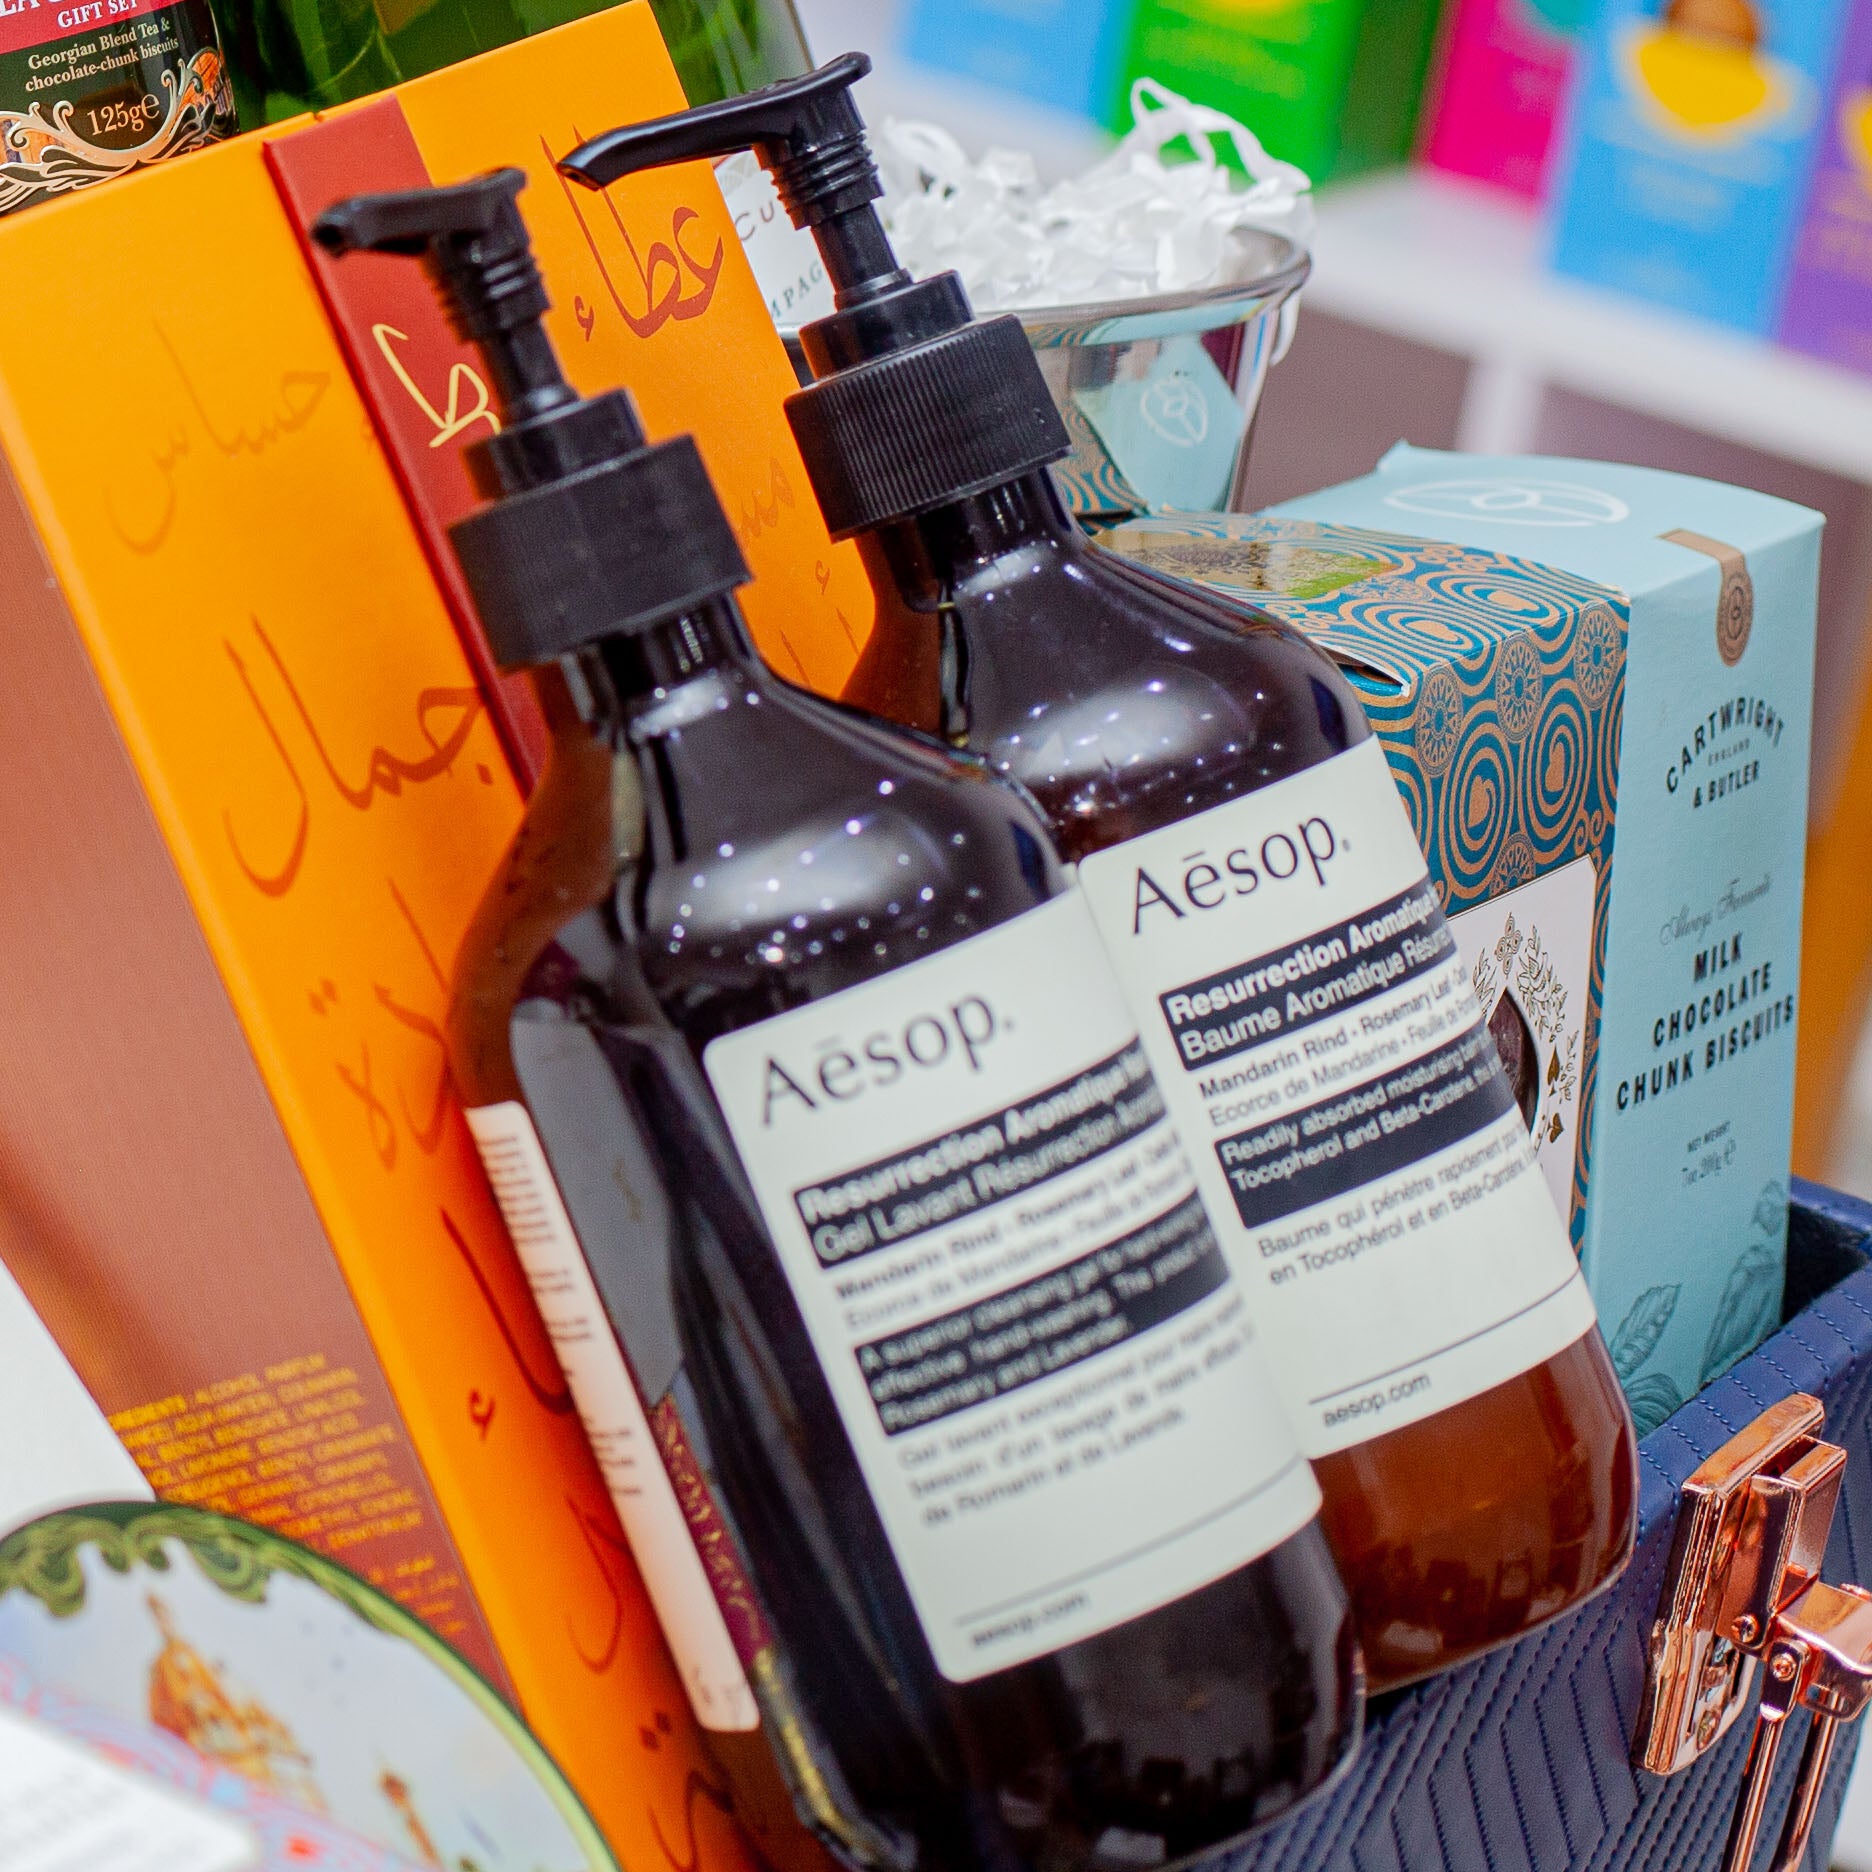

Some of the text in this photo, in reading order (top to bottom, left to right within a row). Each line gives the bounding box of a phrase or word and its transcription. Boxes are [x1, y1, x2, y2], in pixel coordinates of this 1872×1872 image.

[27, 16, 172, 71] Georgian Blend Tea &
[56, 0, 103, 29] GIFT
[25, 36, 180, 93] chocolate-chunk biscuits
[1665, 696, 1785, 795] CARTWRIGHT
[1707, 759, 1761, 803] BUTLER
[1165, 892, 1434, 1025] Resurrection Aromatique
[1693, 930, 1743, 984] MILK
[1178, 1005, 1283, 1062] Baume
[1285, 951, 1407, 1022] Aromatique
[1653, 961, 1773, 1048] CHOCOLATE
[1198, 1048, 1301, 1100] Mandarin
[1301, 1026, 1349, 1059] Rind
[1359, 994, 1432, 1035] Rosemary
[1207, 1085, 1283, 1129] Ecorce
[1283, 1075, 1308, 1098] de
[1310, 1036, 1401, 1084] Mandarine
[1616, 994, 1795, 1111] CHUNK BISCUITS
[1219, 1118, 1301, 1166] Readily
[1300, 1082, 1389, 1136] absorbed
[1229, 1130, 1344, 1192] Tocopherol
[1343, 1118, 1382, 1151] and
[797, 1122, 1006, 1226] Resurrection
[811, 1210, 876, 1262] Gel
[1257, 1221, 1332, 1259] Baume
[1335, 1203, 1367, 1234] qui
[1268, 1261, 1298, 1286] en
[1322, 1373, 1433, 1429] aesop.com
